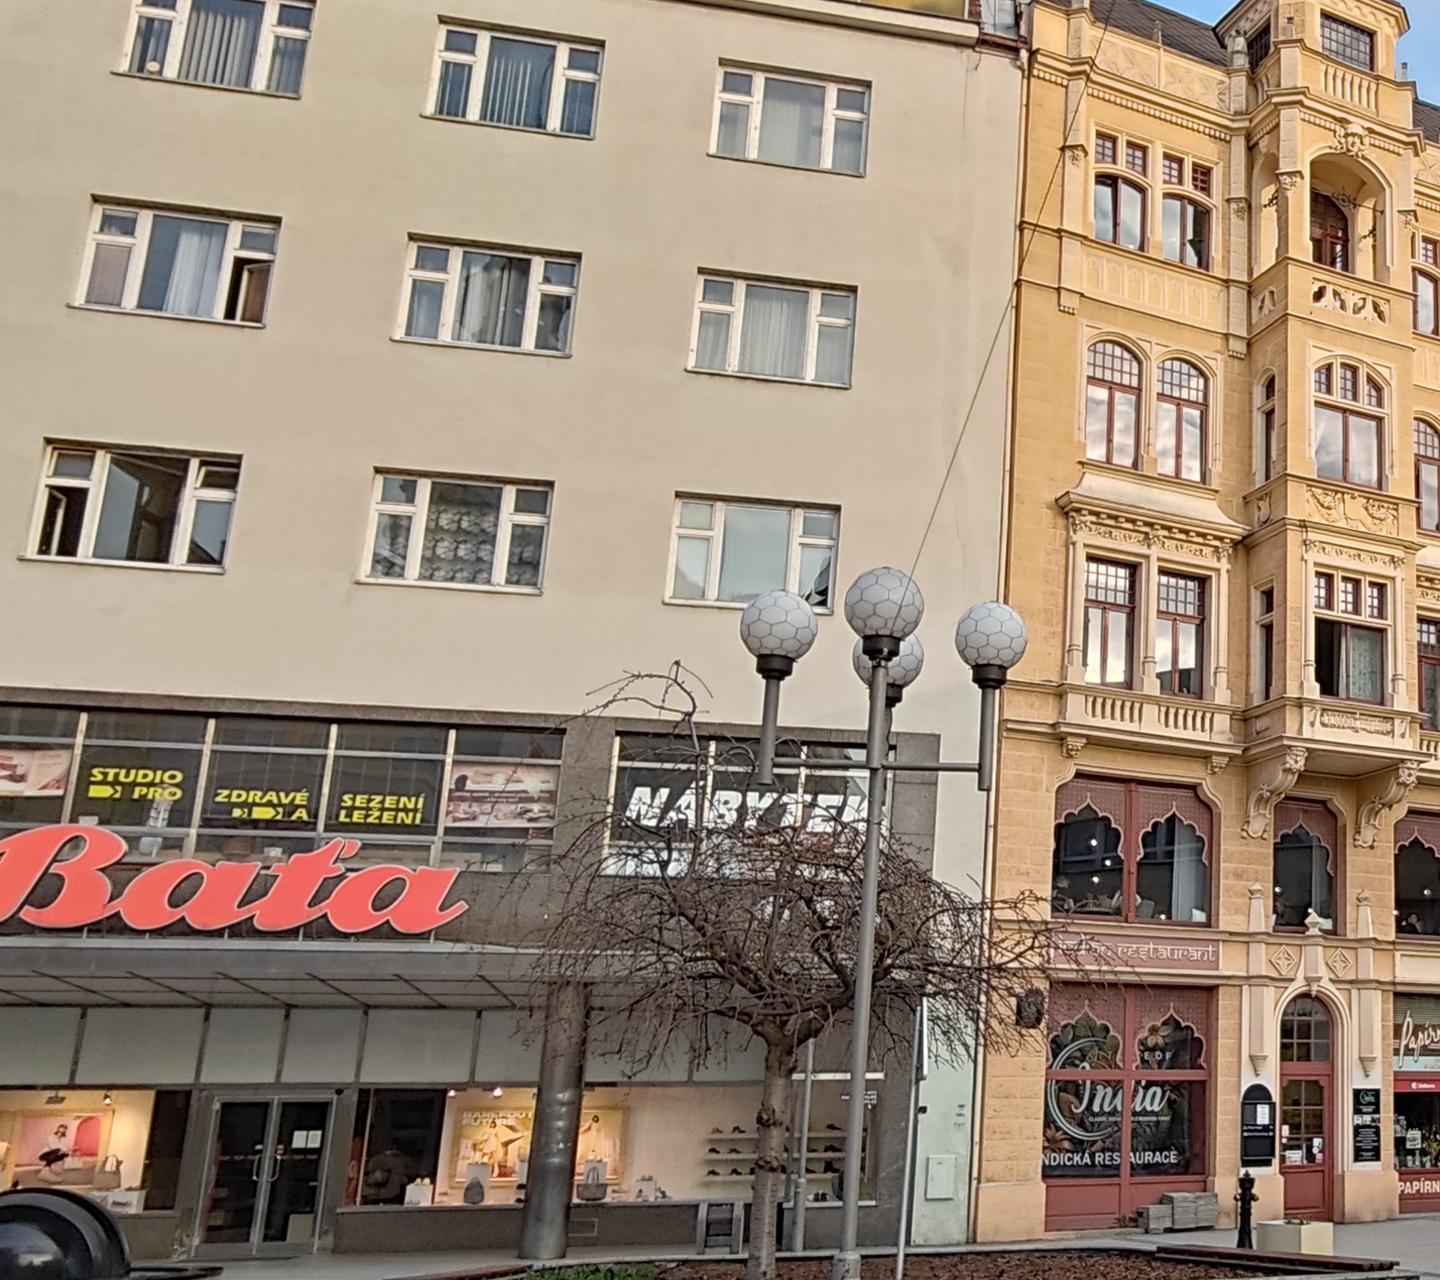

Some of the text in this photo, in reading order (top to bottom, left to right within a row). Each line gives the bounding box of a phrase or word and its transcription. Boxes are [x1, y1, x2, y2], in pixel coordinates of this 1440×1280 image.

[89, 768, 183, 783] STUDIO
[132, 785, 183, 800] PRO
[214, 788, 309, 805] ZDRAVÉ
[340, 792, 425, 809] SEZENÍ
[292, 808, 309, 821] A
[338, 807, 423, 825] LEŽENÍ
[1117, 942, 1217, 962] restaurant
[1039, 1149, 1178, 1167] NDICKÁ RESAURACE
